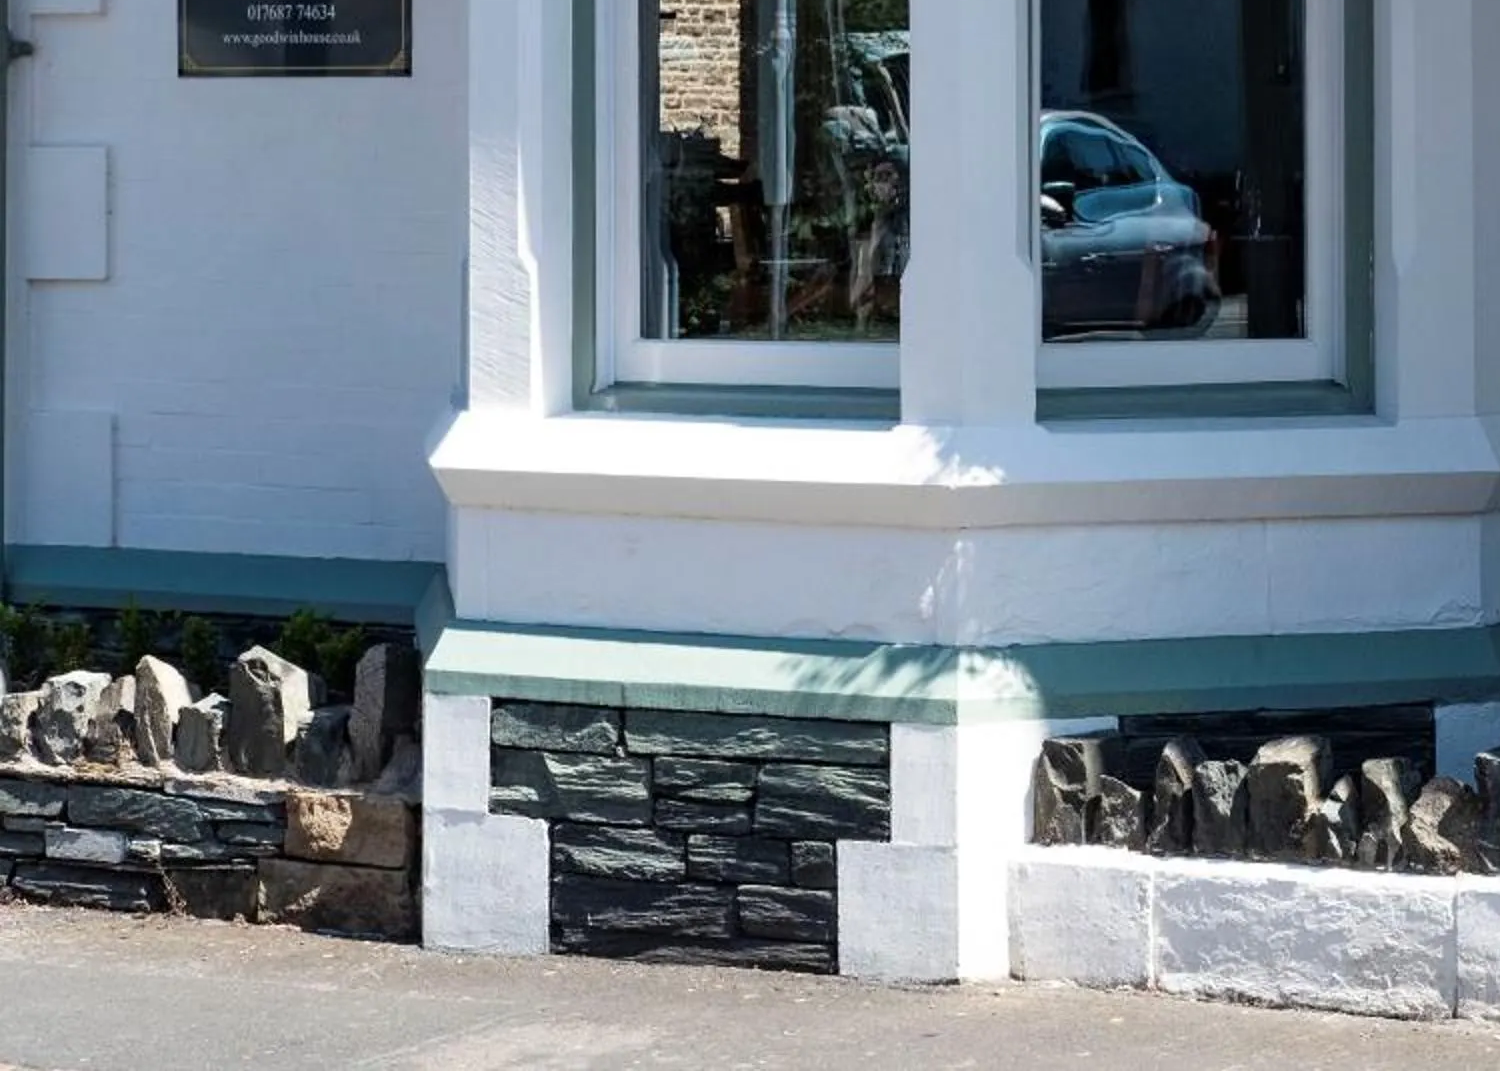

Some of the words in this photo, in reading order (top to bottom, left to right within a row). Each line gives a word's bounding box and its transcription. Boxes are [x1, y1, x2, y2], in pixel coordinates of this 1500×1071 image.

[246, 4, 294, 21] 017687
[297, 3, 336, 21] 74634
[222, 28, 361, 45] www.goodwinhouse.co.uk
